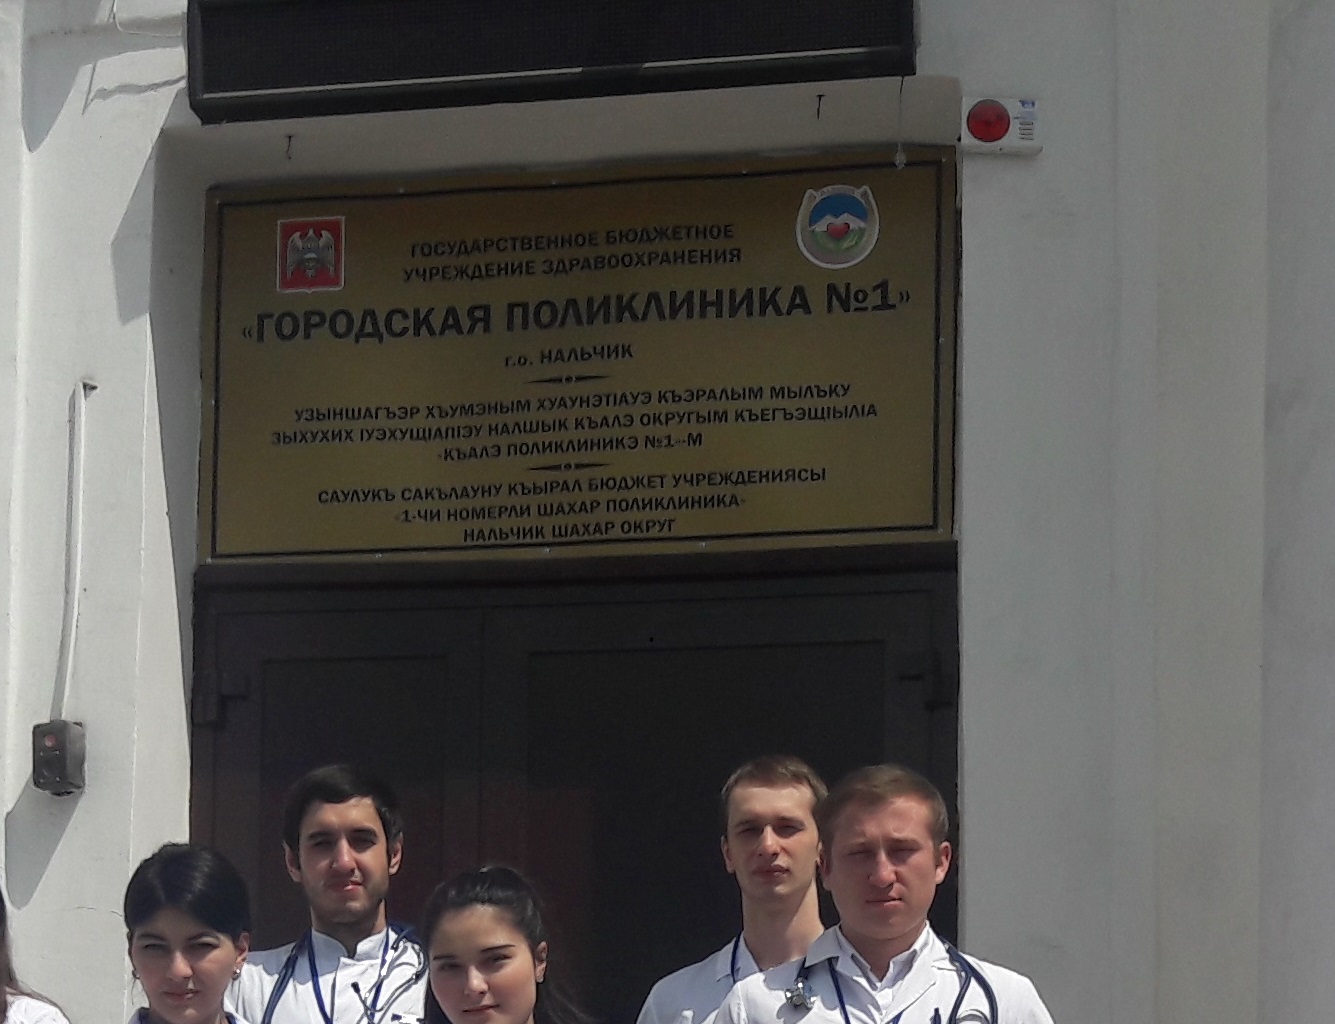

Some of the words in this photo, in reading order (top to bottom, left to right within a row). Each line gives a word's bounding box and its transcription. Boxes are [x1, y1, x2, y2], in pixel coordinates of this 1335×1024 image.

[411, 232, 598, 258] ГОСУДАРСТВЕННОЕ
[606, 224, 734, 244] БЮДЖЕТНОЕ
[403, 261, 535, 282] УЧРЕЖДЕНИЕ
[543, 248, 741, 276] ЗДРАВООХРАНЕНИЯ
[242, 304, 490, 344] «ГОРОДСКАЯ
[507, 285, 812, 331] ПОЛИКЛИНИКА
[827, 279, 910, 314] №1»
[540, 343, 633, 364] НАЛЬЧИК
[770, 384, 851, 399] МЫЛЪКУ
[489, 418, 568, 436] НАЛШЫК
[575, 414, 634, 430] КЪАЛЭ
[640, 410, 728, 426] ОКРУГЫМ
[507, 436, 638, 457] ПОЛИКЛИНИКЭ
[318, 488, 395, 504] САУЛУКЪ
[401, 484, 502, 501] САКЪЛАУНУ
[508, 479, 582, 496] КЪЫРАЛ
[588, 474, 666, 492] БЮДЖЕТ
[672, 467, 826, 488] УЧРЕЖДЕНИЯСЫ
[447, 505, 530, 521] НОМЕРЛИ
[538, 500, 600, 516] ШАХАР
[464, 526, 545, 542] НАЛЬЧИК
[552, 522, 615, 537] ШАХАР
[621, 519, 675, 534] ОКРУГ
